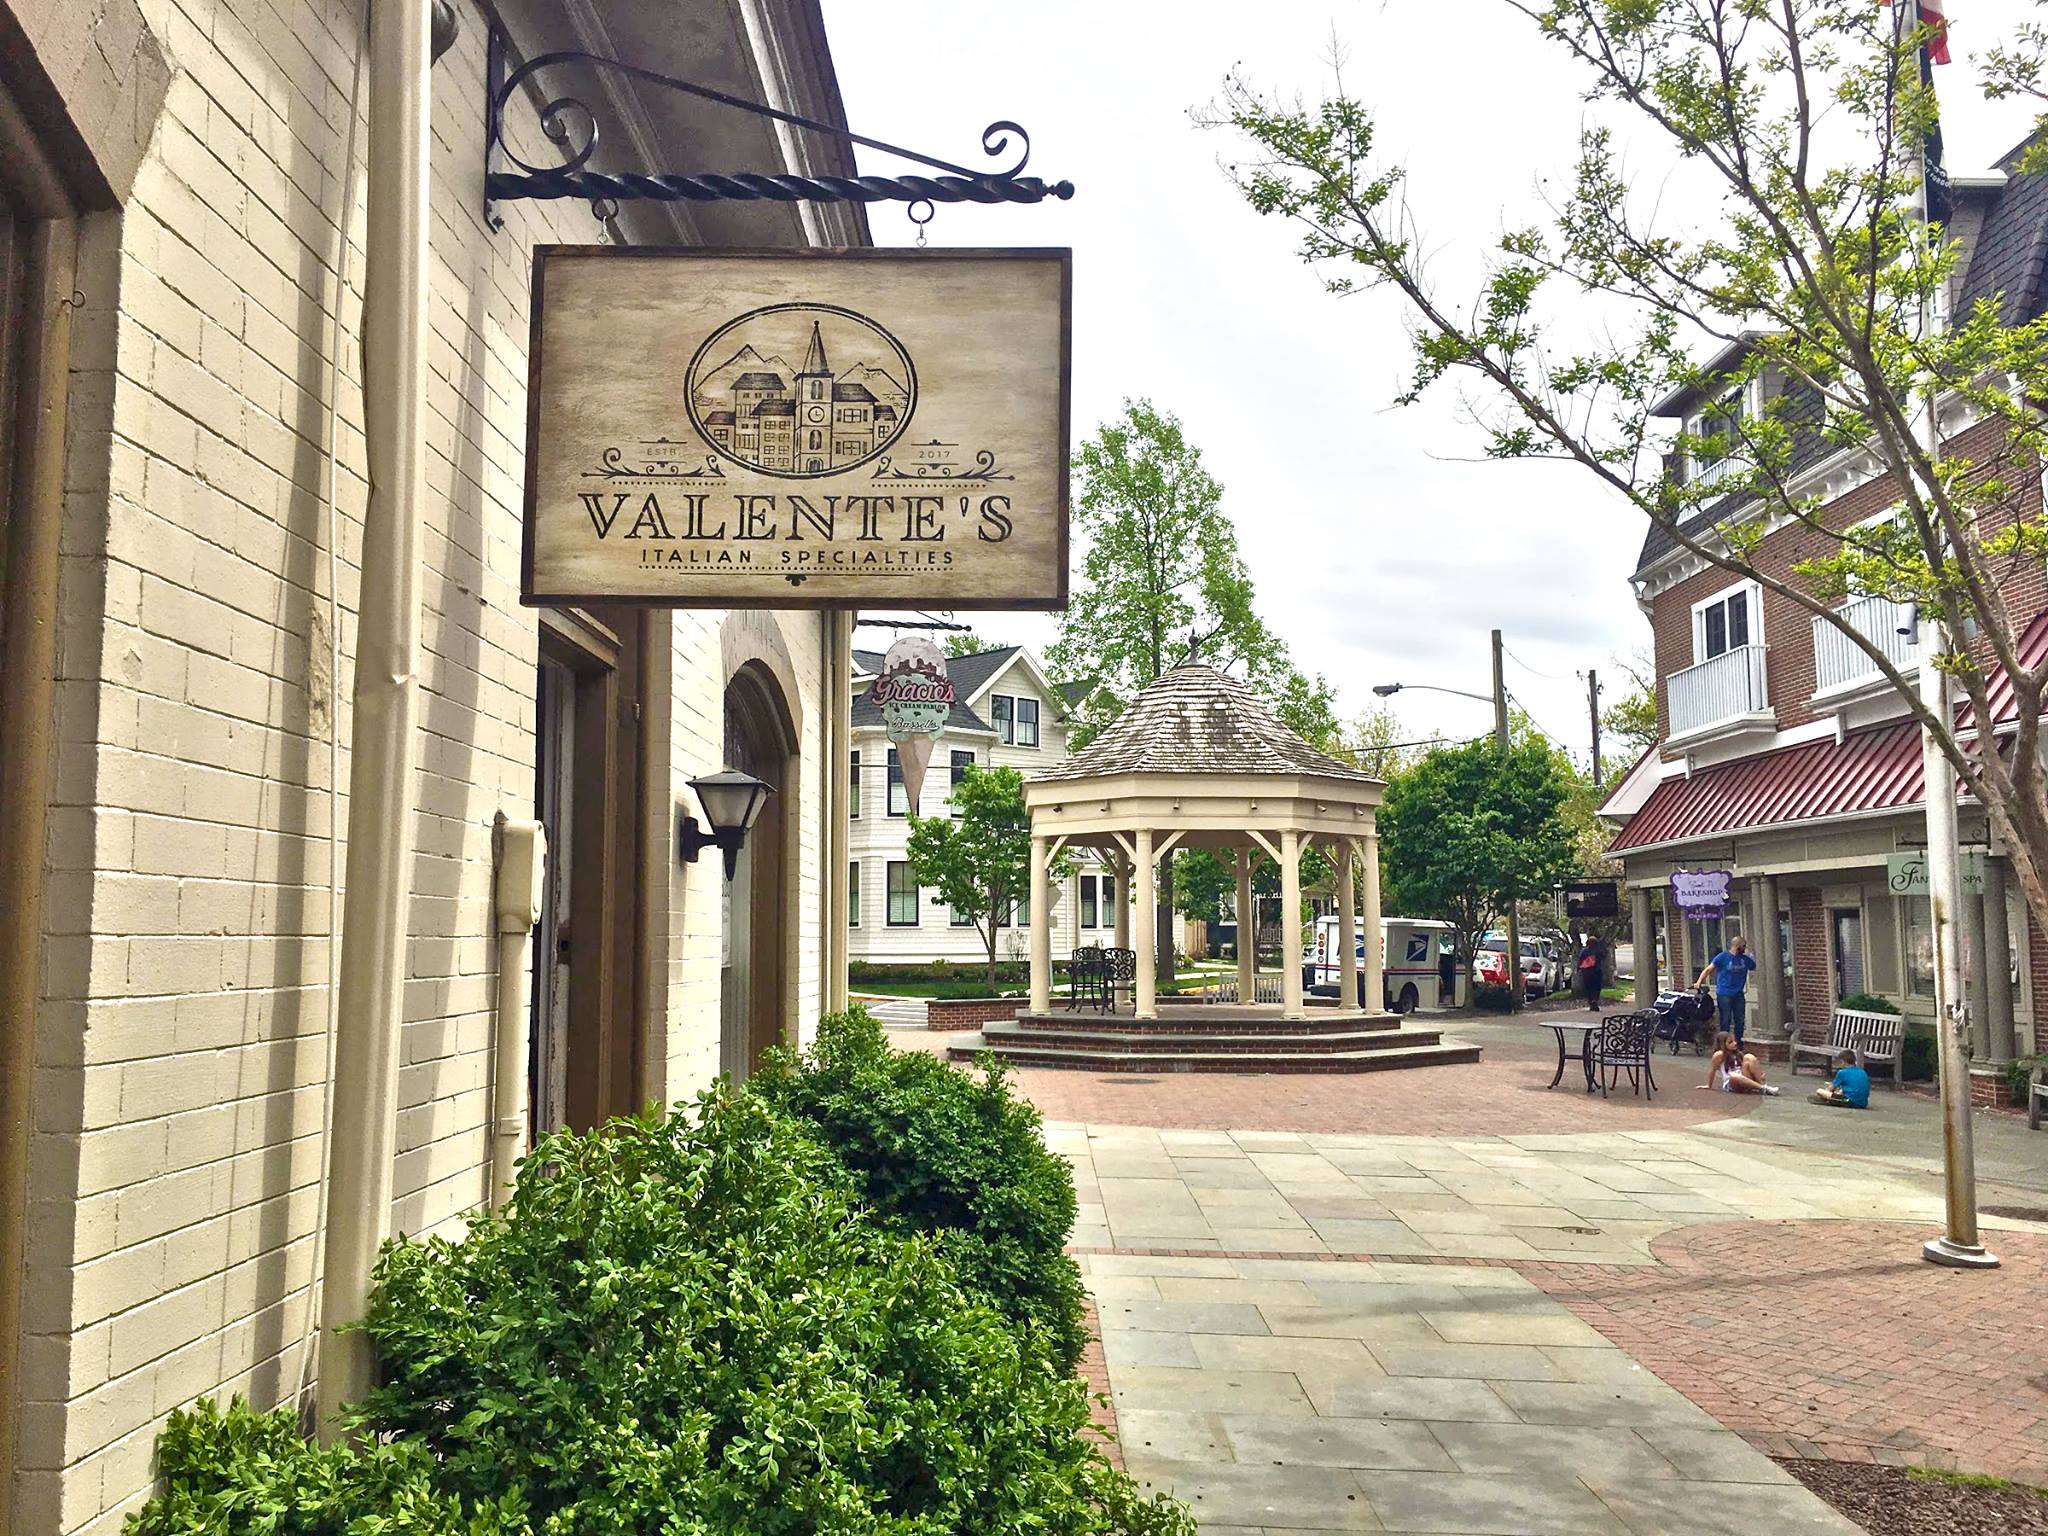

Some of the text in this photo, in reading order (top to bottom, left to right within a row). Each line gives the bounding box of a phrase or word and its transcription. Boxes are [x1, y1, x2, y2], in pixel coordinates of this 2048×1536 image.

[918, 450, 951, 459] 2017
[577, 491, 1013, 543] VALENTE'S
[641, 548, 953, 565] ITALIAN SPECIALTIES
[1962, 875, 1982, 884] SPA
